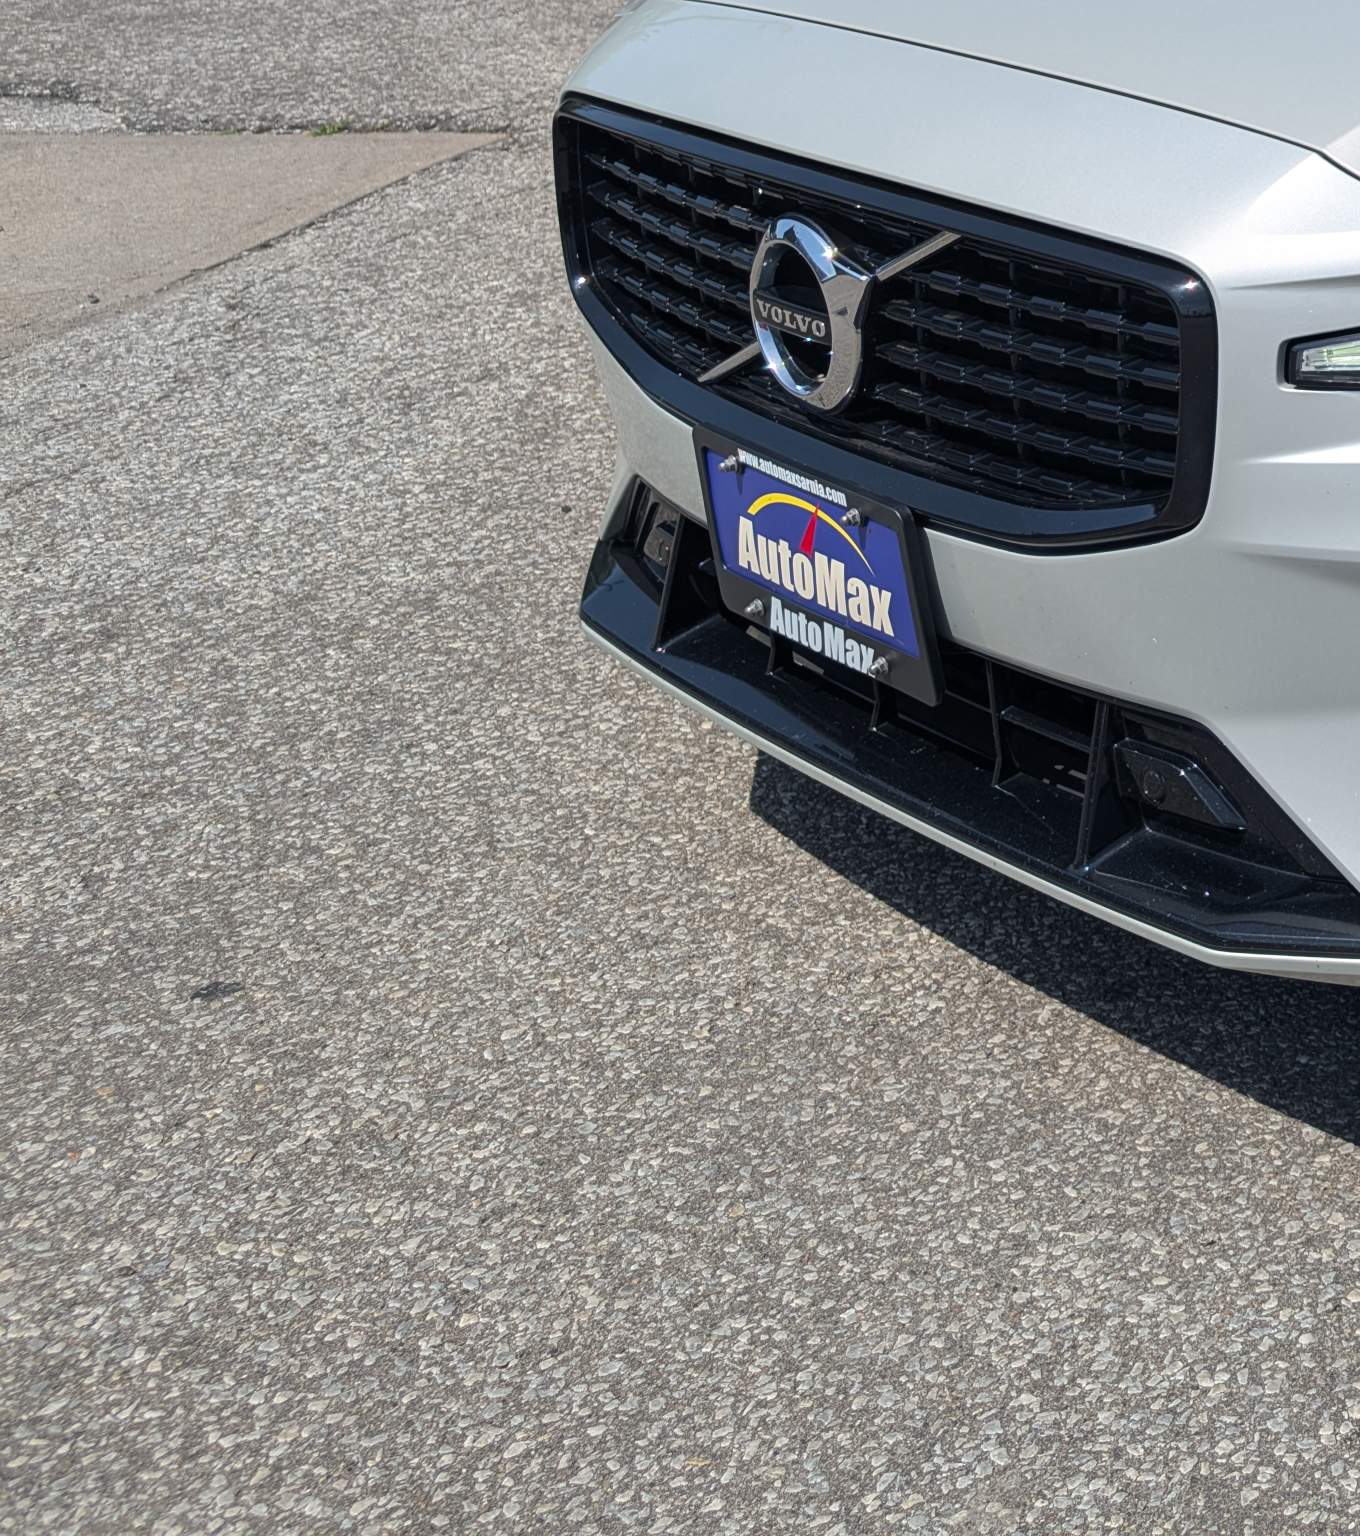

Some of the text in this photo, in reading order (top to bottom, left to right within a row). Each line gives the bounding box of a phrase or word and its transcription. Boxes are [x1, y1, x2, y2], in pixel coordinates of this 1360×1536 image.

[756, 298, 827, 338] VOLVO
[737, 447, 848, 508] www.automaxsarnia.com
[738, 515, 895, 638] AutoMax
[769, 596, 876, 677] AutoMax
